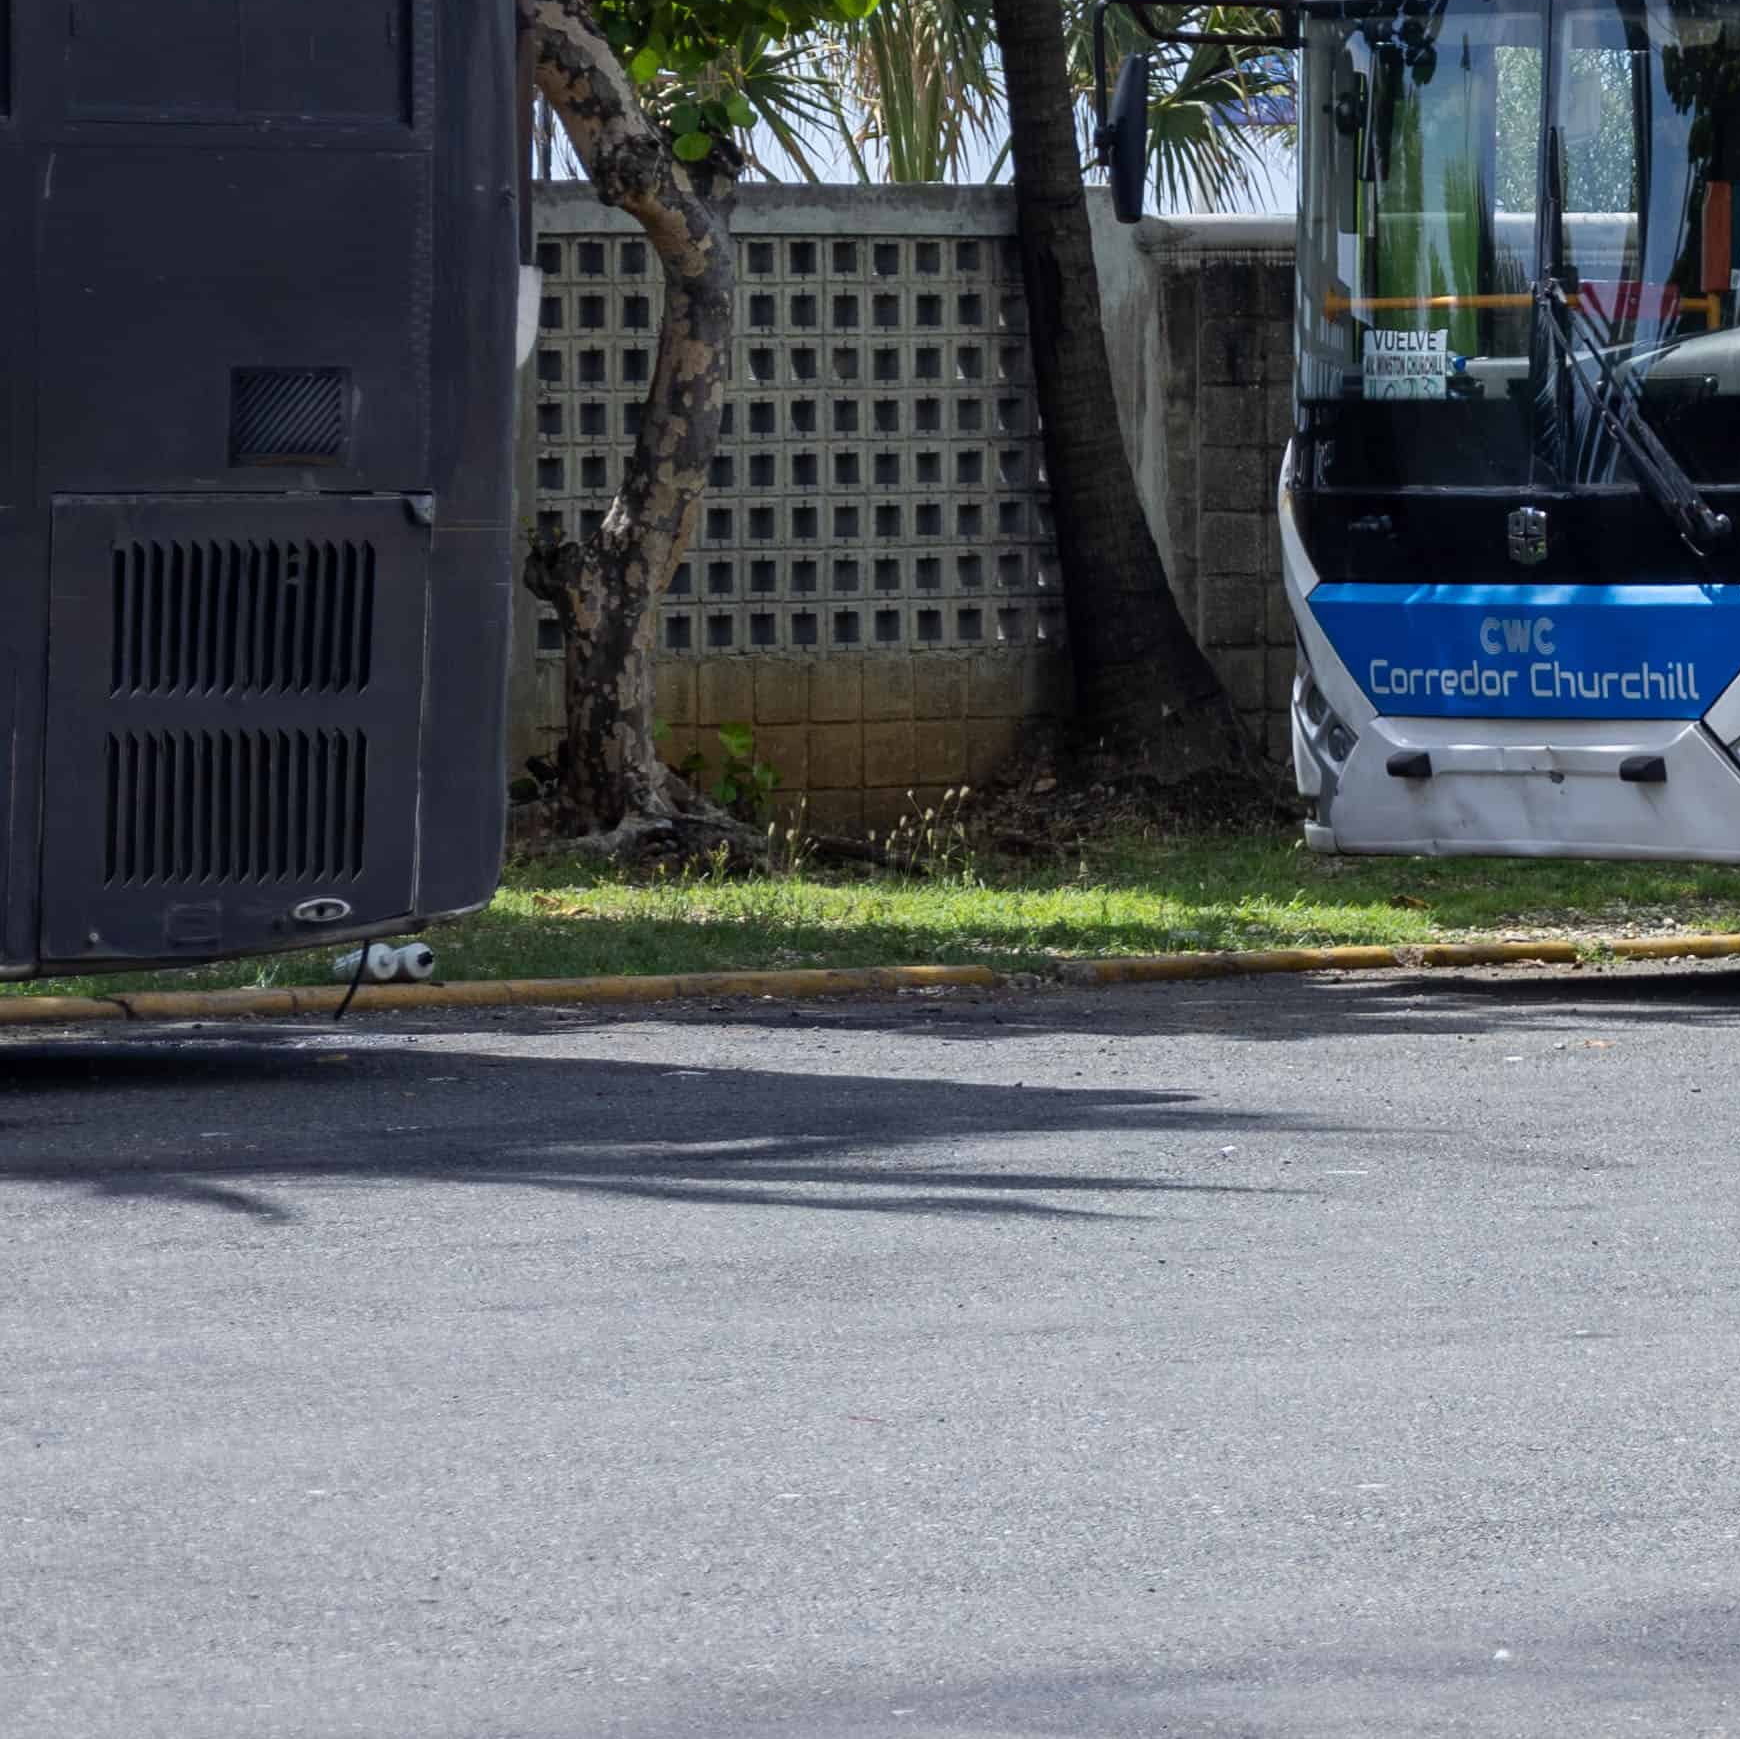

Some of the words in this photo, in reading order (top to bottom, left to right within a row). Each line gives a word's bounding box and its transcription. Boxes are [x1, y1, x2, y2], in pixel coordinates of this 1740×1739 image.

[1374, 330, 1437, 351] VUELVE
[1480, 617, 1557, 655] CWC
[1370, 660, 1518, 697] Corredor
[1530, 661, 1699, 700] Churchill
